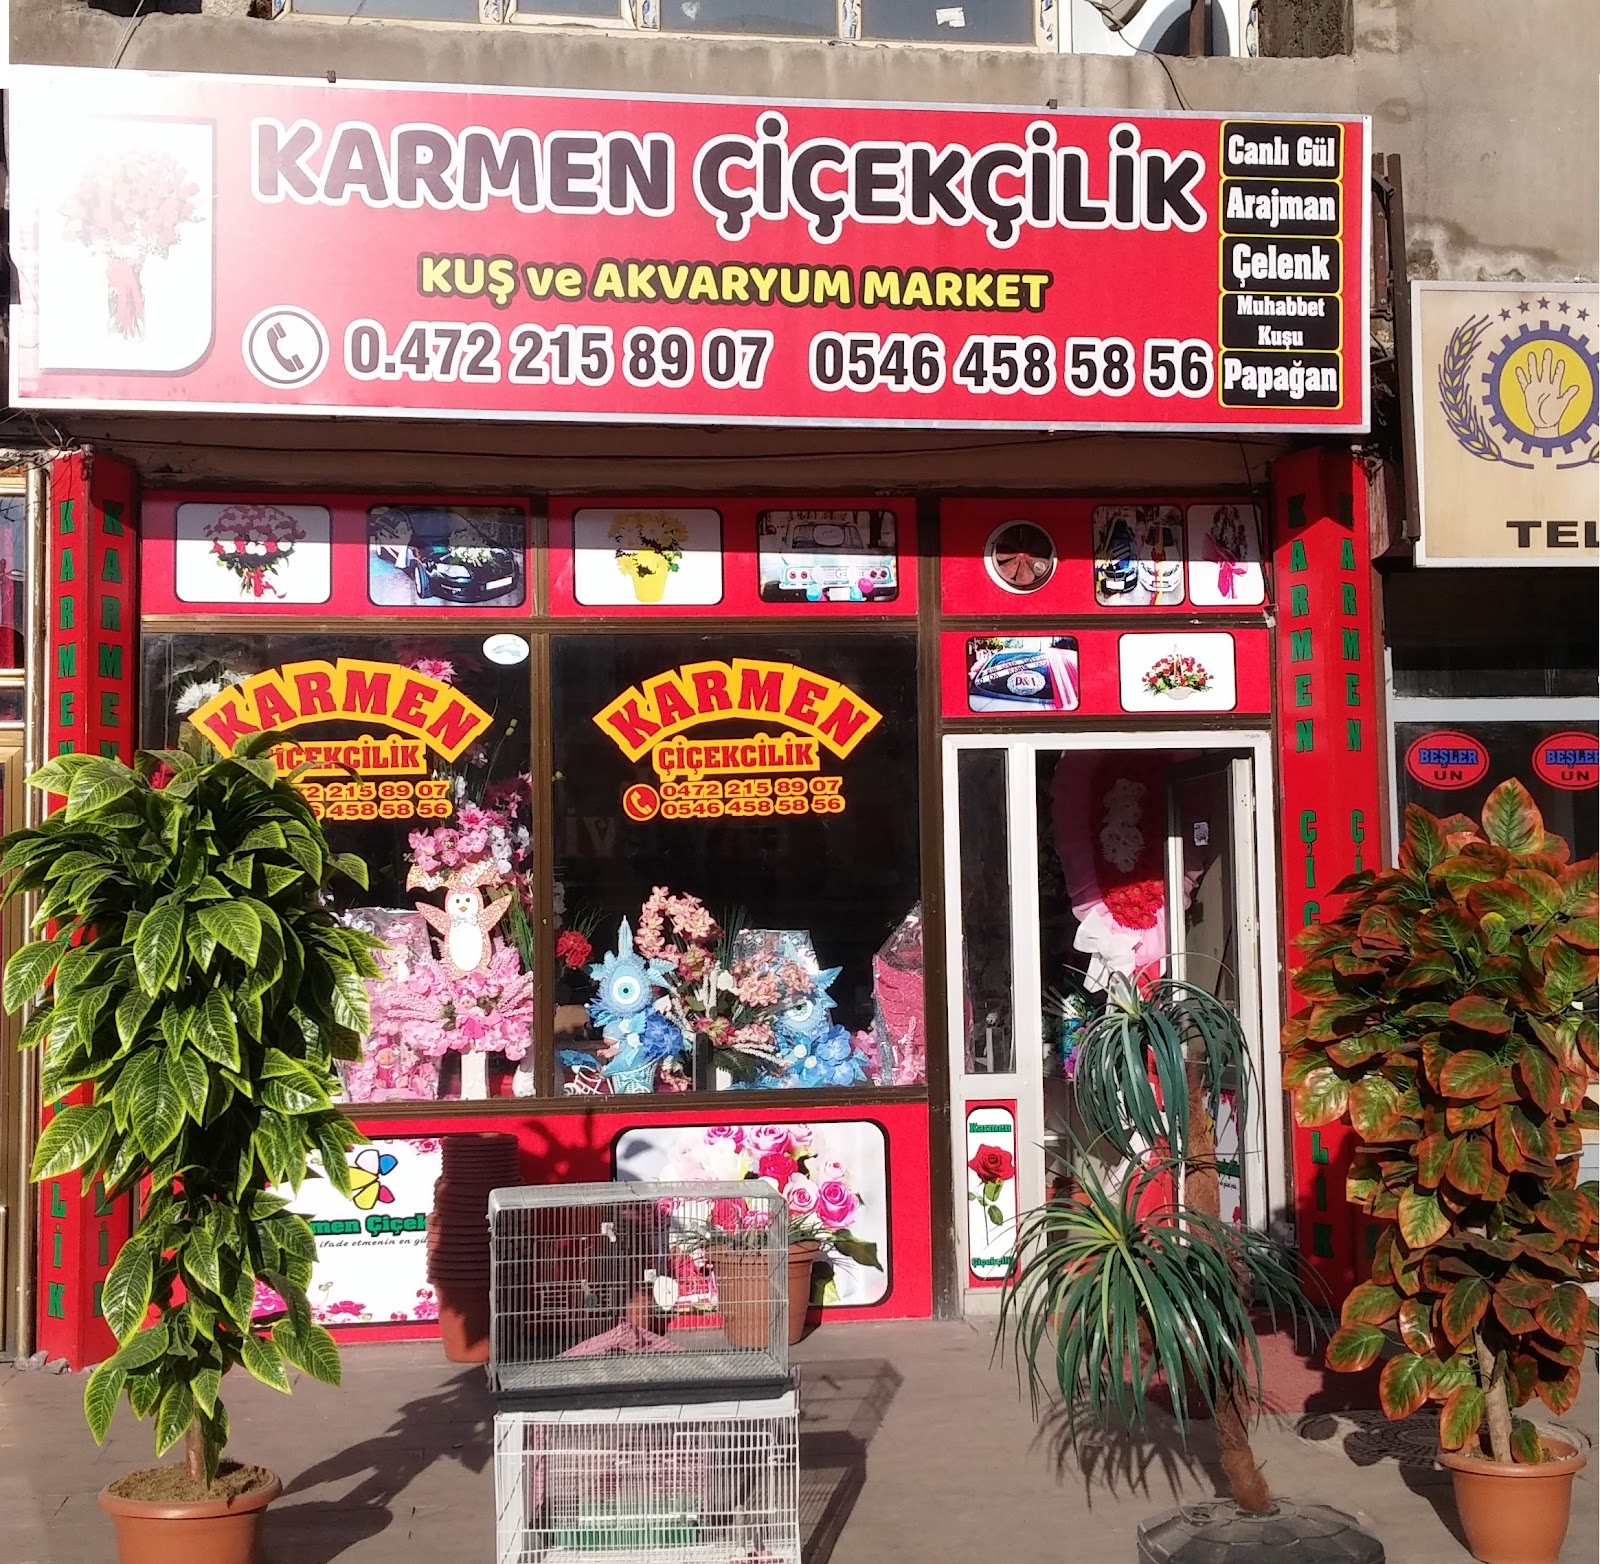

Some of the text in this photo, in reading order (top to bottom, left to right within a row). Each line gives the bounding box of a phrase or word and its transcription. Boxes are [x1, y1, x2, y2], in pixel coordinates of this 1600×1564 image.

[1227, 133, 1336, 168] Canlı Gül
[254, 115, 1203, 244] KARMEN ÇİÇEKÇİLİK
[1226, 186, 1336, 228] Arajman
[420, 255, 1051, 310] KUŞ ve AKVARYUM MARKET
[1231, 242, 1331, 288] Çelenk
[1236, 294, 1326, 318] Muhabbet
[348, 323, 769, 385] 0.472 215 89 07
[1257, 324, 1304, 350] Kuşu
[813, 336, 1210, 394] 0546 458 58 56
[1223, 356, 1338, 400] Papağan
[199, 666, 484, 754] KARMEN
[604, 666, 873, 753] KARMEN
[1419, 748, 1478, 768] BEŞLER
[1433, 770, 1463, 781] UN
[1560, 770, 1590, 781] UN
[328, 784, 374, 798] 215
[380, 784, 411, 797] 89
[417, 783, 448, 797] 07
[662, 779, 841, 798] 0472 215 89 07
[329, 802, 375, 817] 458
[380, 802, 411, 816] 58
[418, 801, 448, 815] 56
[662, 797, 843, 817] 0546 458 58 56
